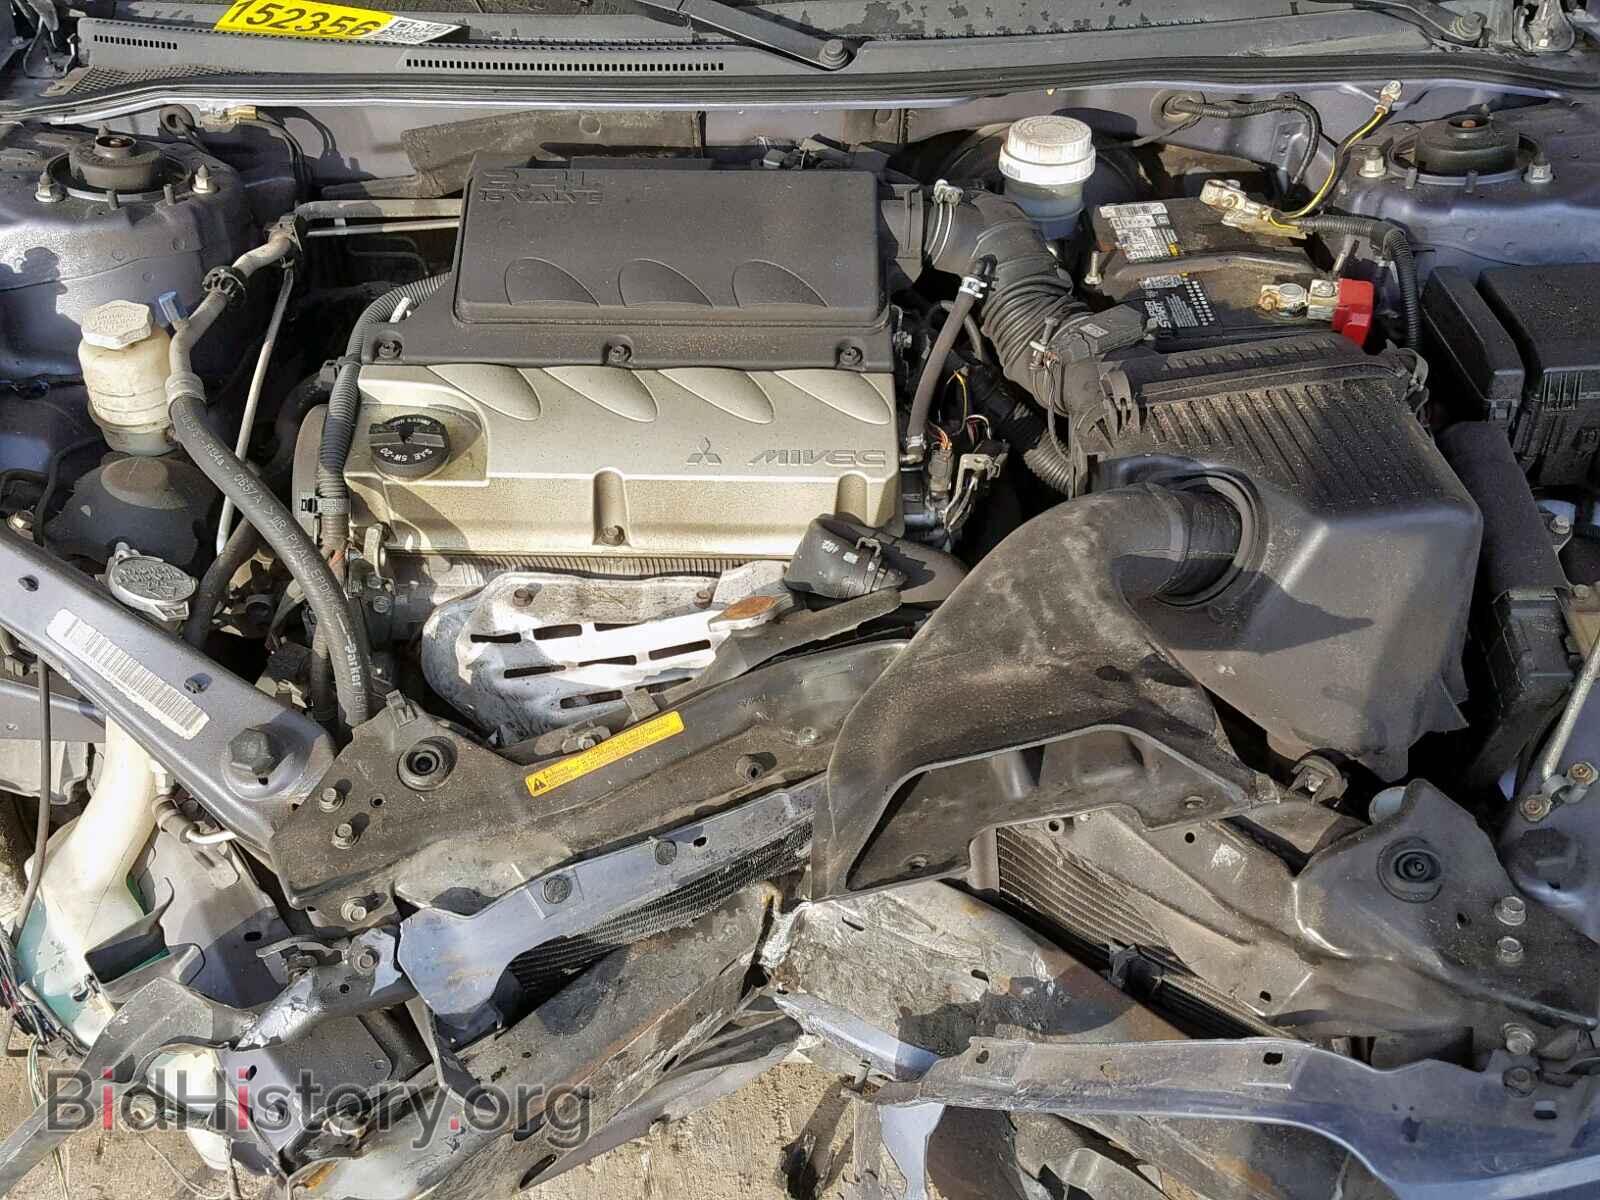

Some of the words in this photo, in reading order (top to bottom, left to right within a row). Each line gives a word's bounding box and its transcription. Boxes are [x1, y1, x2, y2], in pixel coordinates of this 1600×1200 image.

[229, 1, 381, 36] 152356
[380, 447, 408, 461] 5W-20
[413, 448, 433, 461] SAE
[750, 449, 886, 466] MIVEC
[344, 642, 362, 687] Parker
